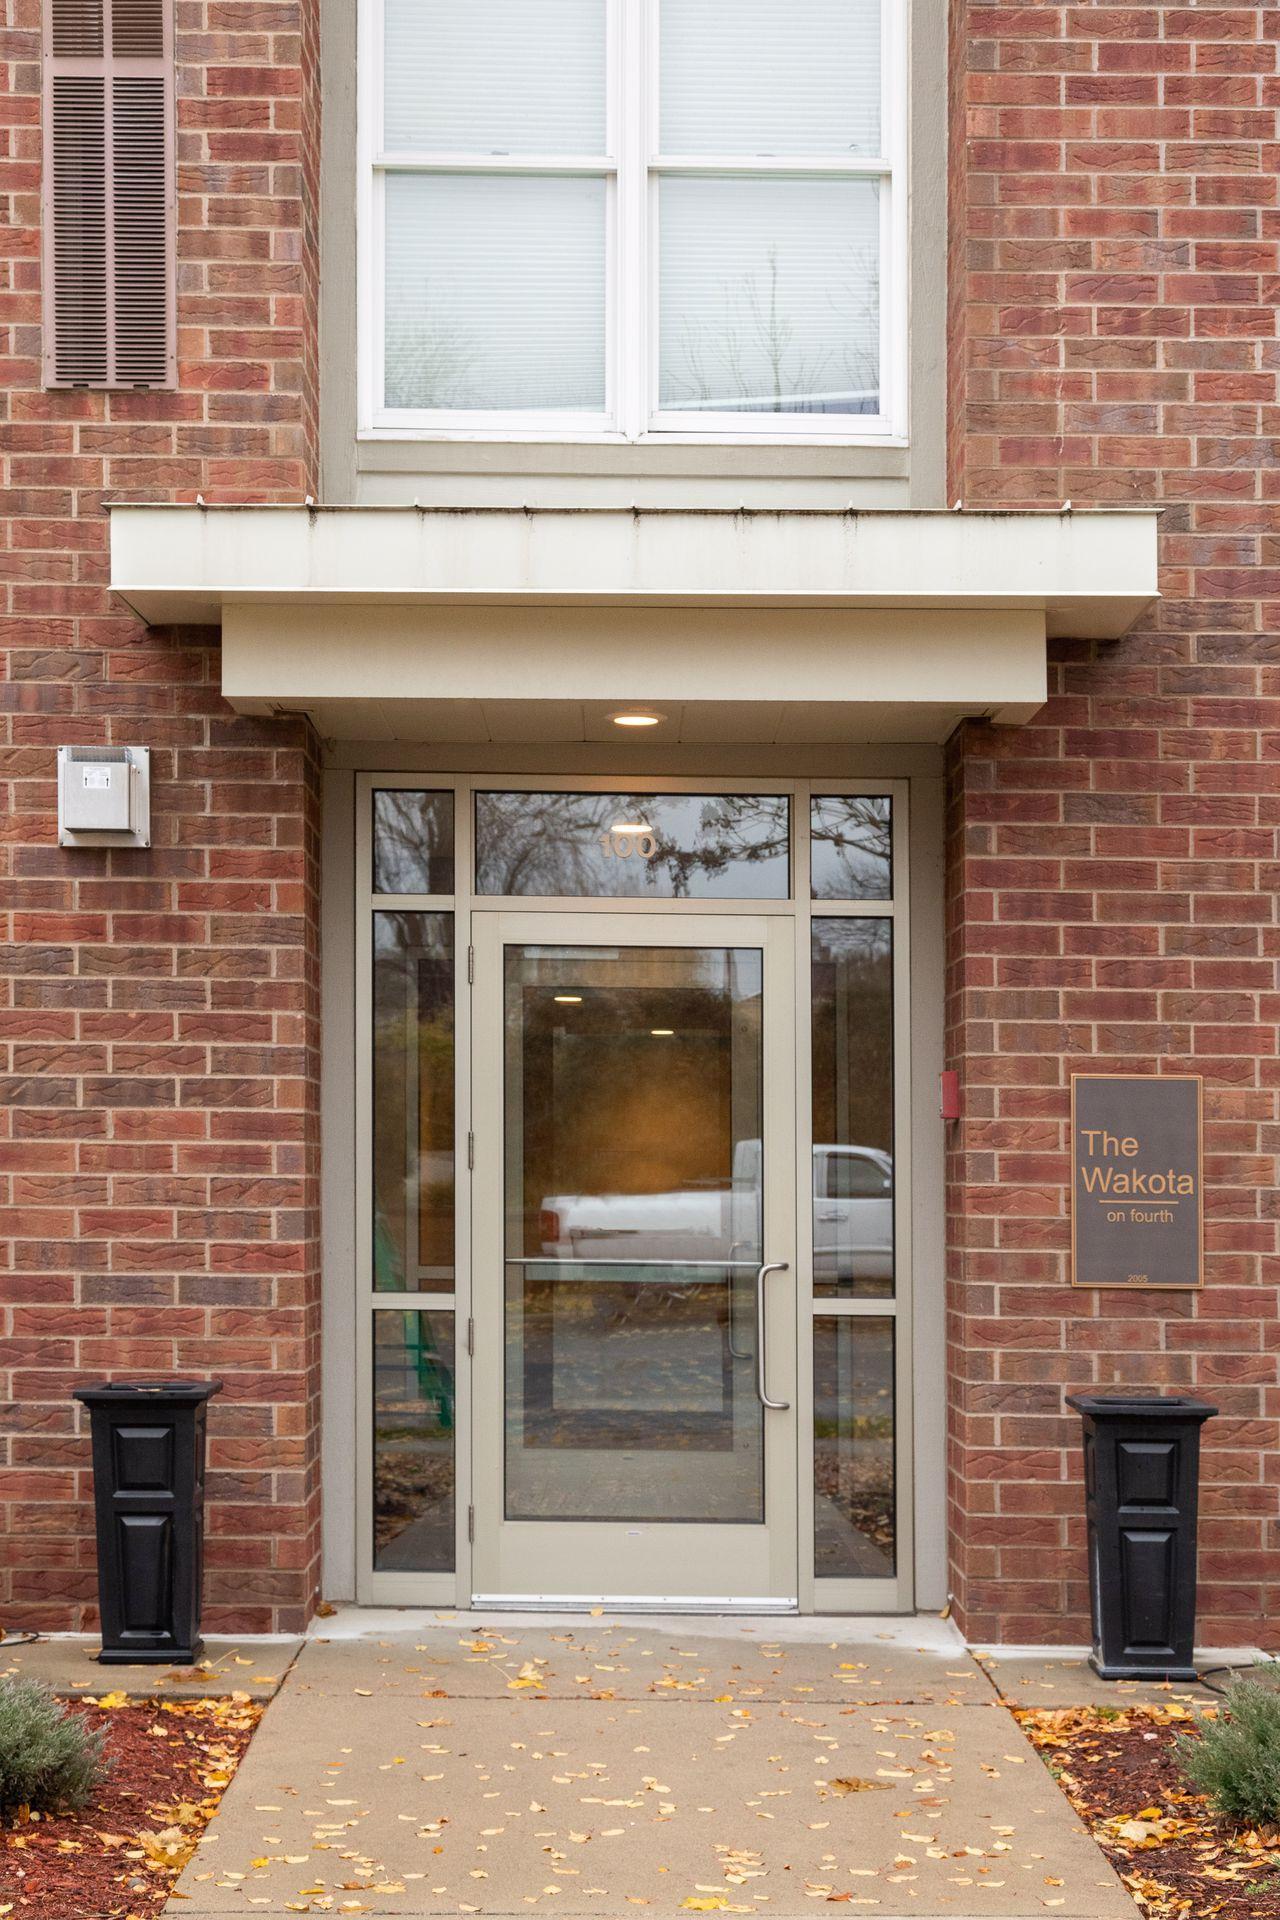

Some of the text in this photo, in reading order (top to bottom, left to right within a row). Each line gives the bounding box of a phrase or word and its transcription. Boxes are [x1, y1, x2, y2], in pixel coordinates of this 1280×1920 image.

[599, 831, 656, 859] 100
[1080, 1130, 1139, 1157] The
[1080, 1166, 1195, 1195] Wakota
[1106, 1208, 1174, 1223] on fourth
